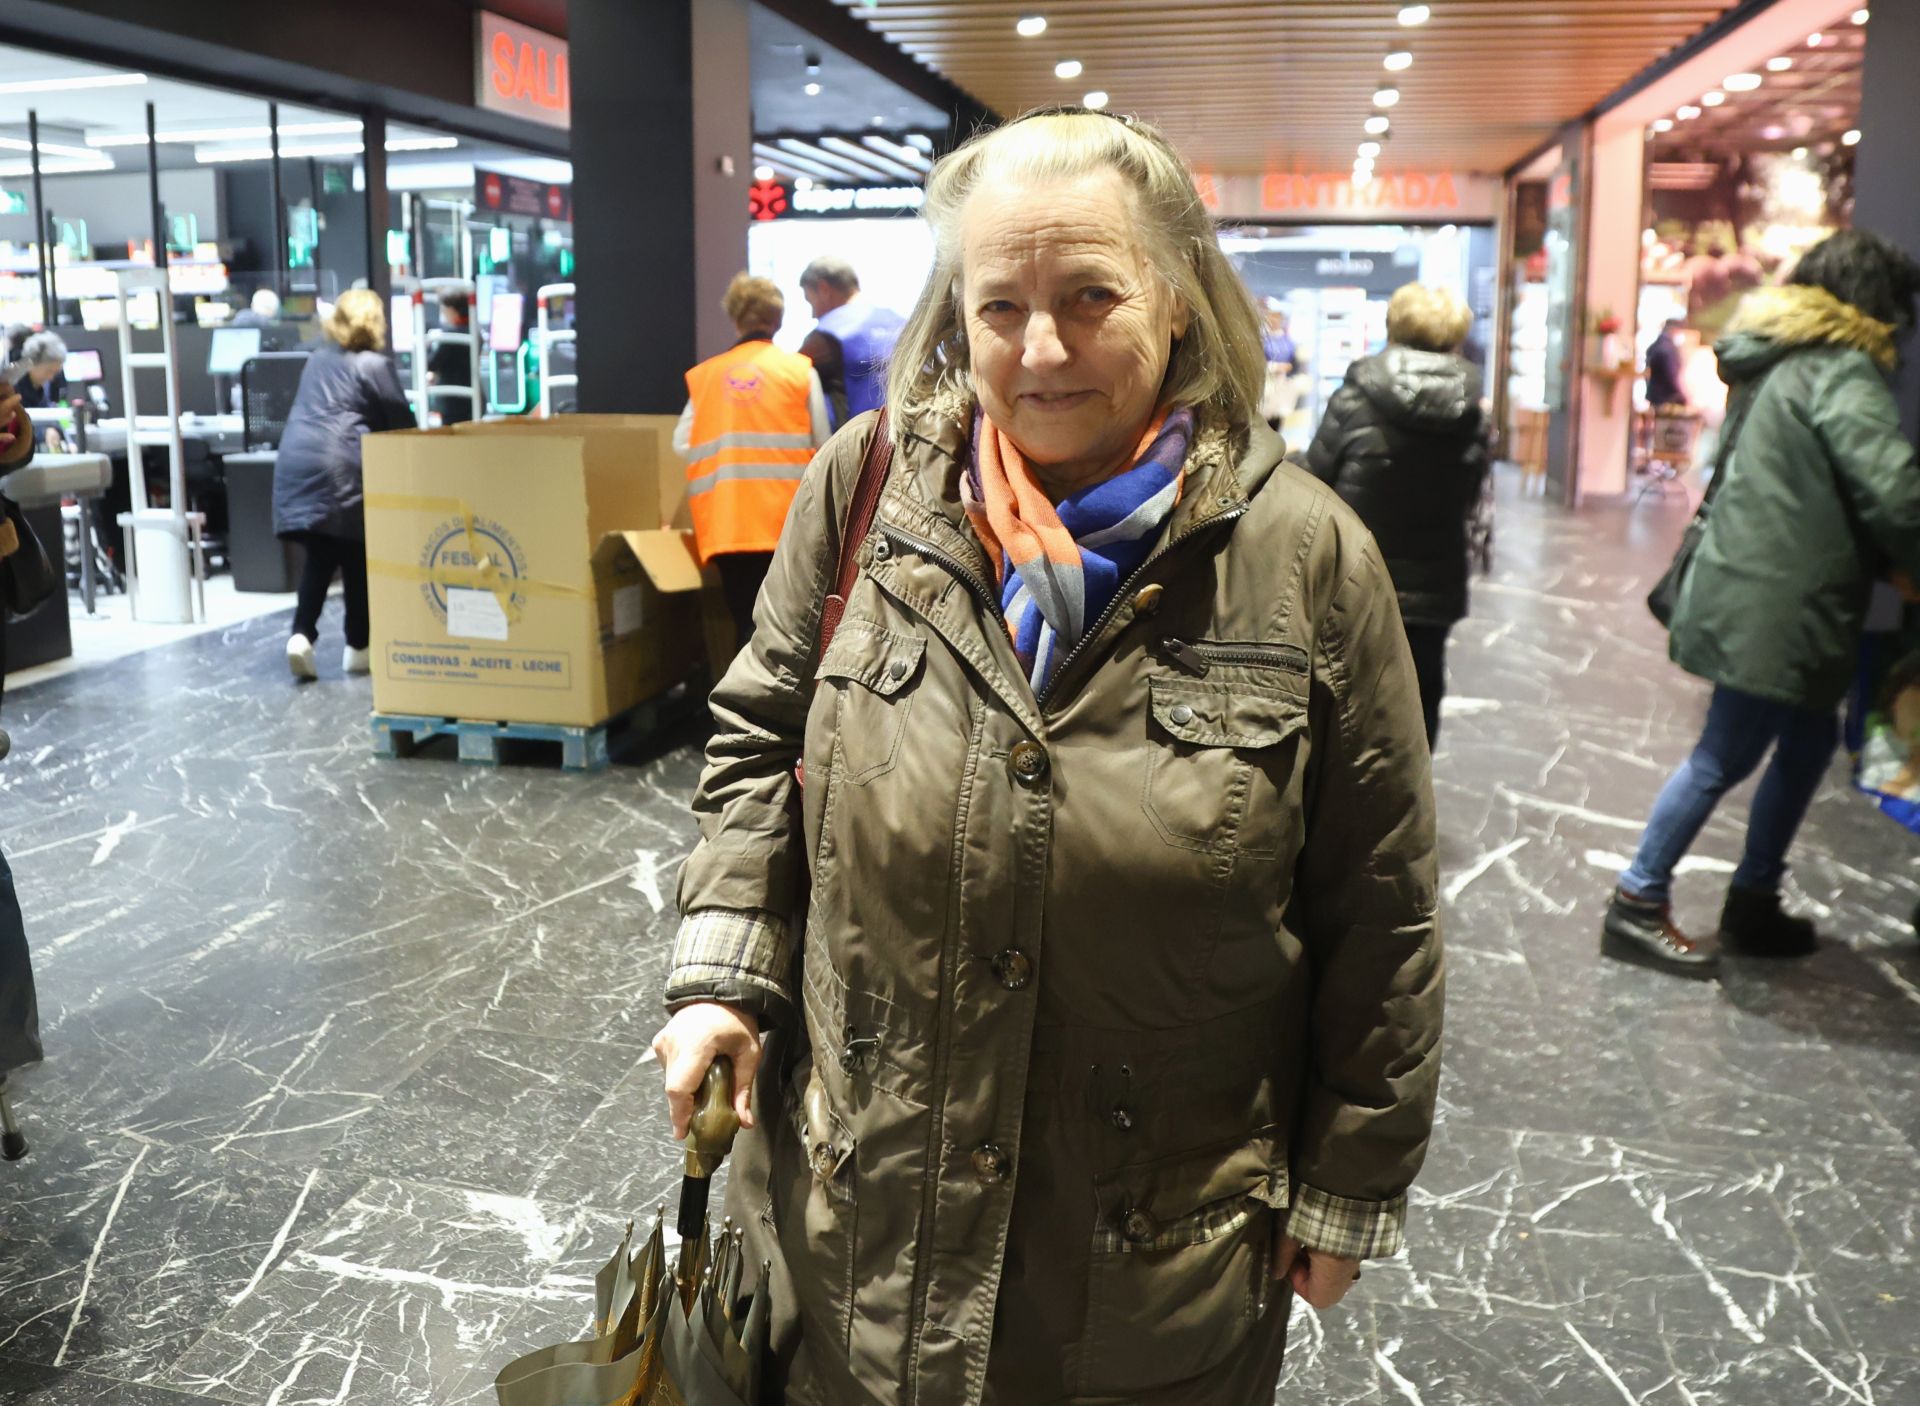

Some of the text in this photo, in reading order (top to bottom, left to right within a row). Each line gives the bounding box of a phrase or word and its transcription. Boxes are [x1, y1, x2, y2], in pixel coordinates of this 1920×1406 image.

[1261, 172, 1459, 210] ENTRADA
[472, 515, 528, 571] ALIMENTOS
[391, 652, 562, 673] CONSERVAS ACEITE LECHE
